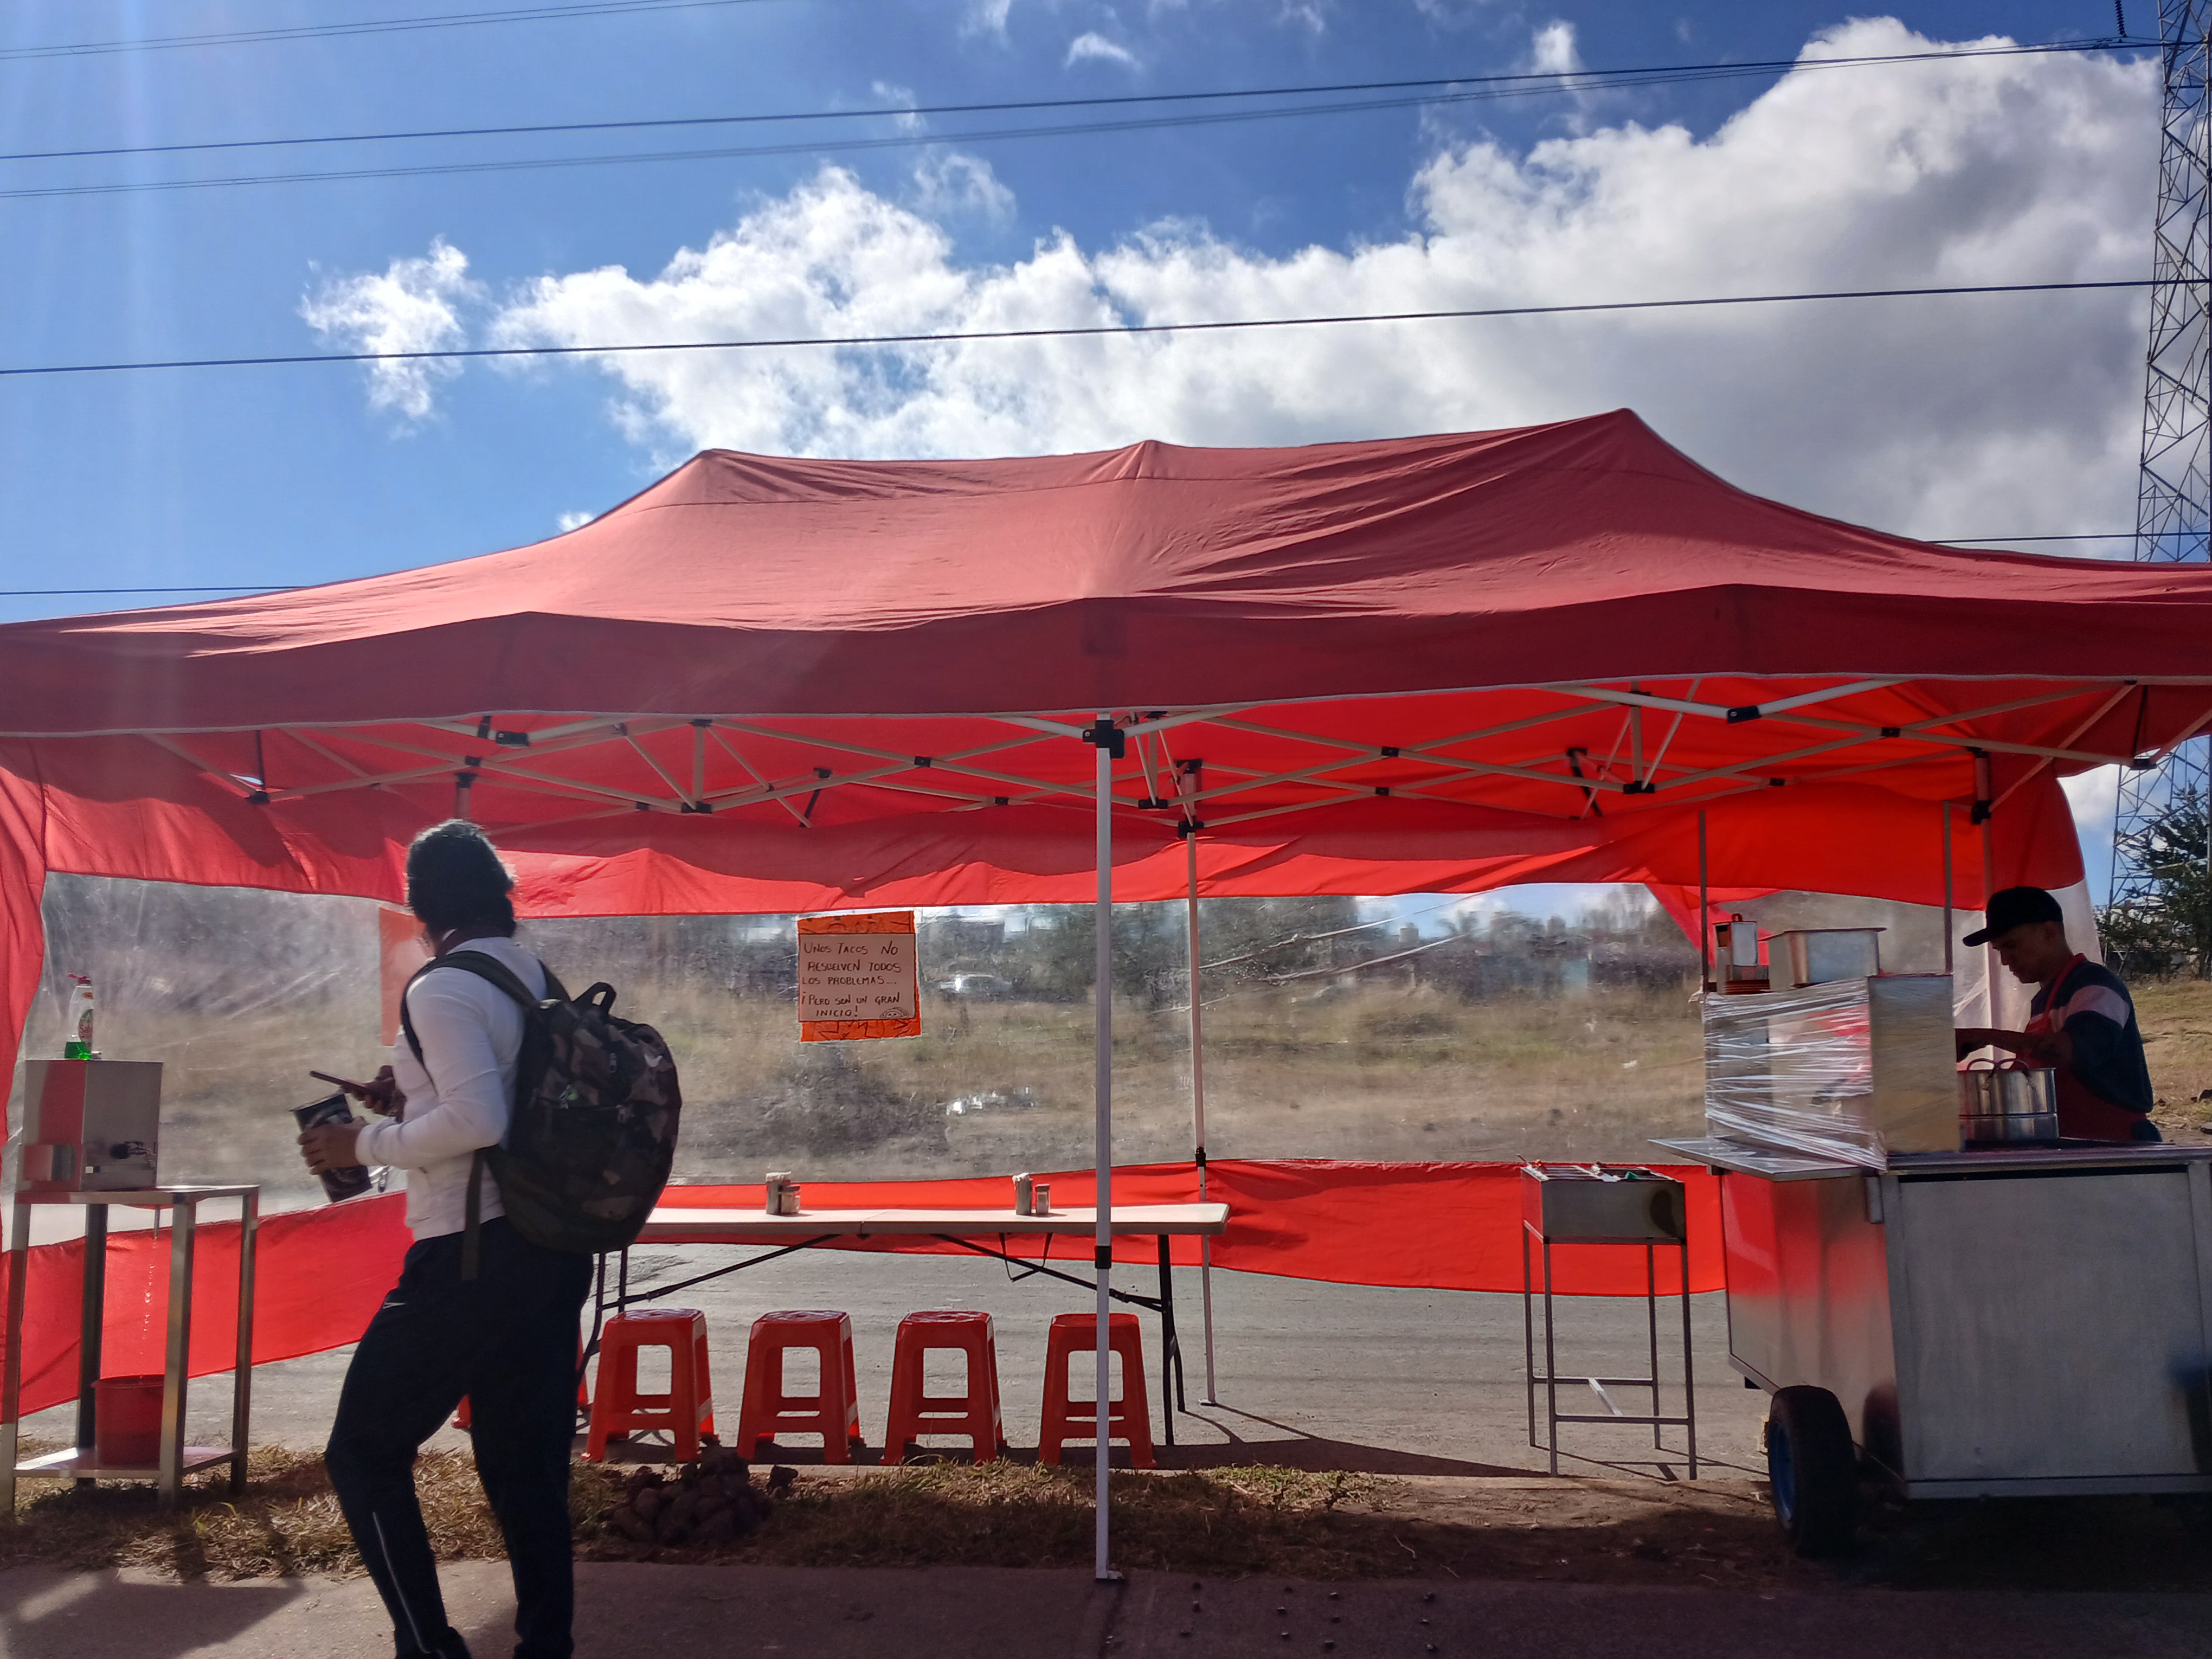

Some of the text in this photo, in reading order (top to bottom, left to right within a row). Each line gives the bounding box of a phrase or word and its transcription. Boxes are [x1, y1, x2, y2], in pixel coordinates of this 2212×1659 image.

[804, 941, 898, 955] UNOS TACOS NO
[807, 959, 902, 973] RESUELVEN TODOS
[828, 976, 897, 985] PROBLEMAS...
[835, 994, 851, 1005] SON
[874, 992, 900, 1005] GRAN
[816, 1005, 858, 1017] INICIO!
